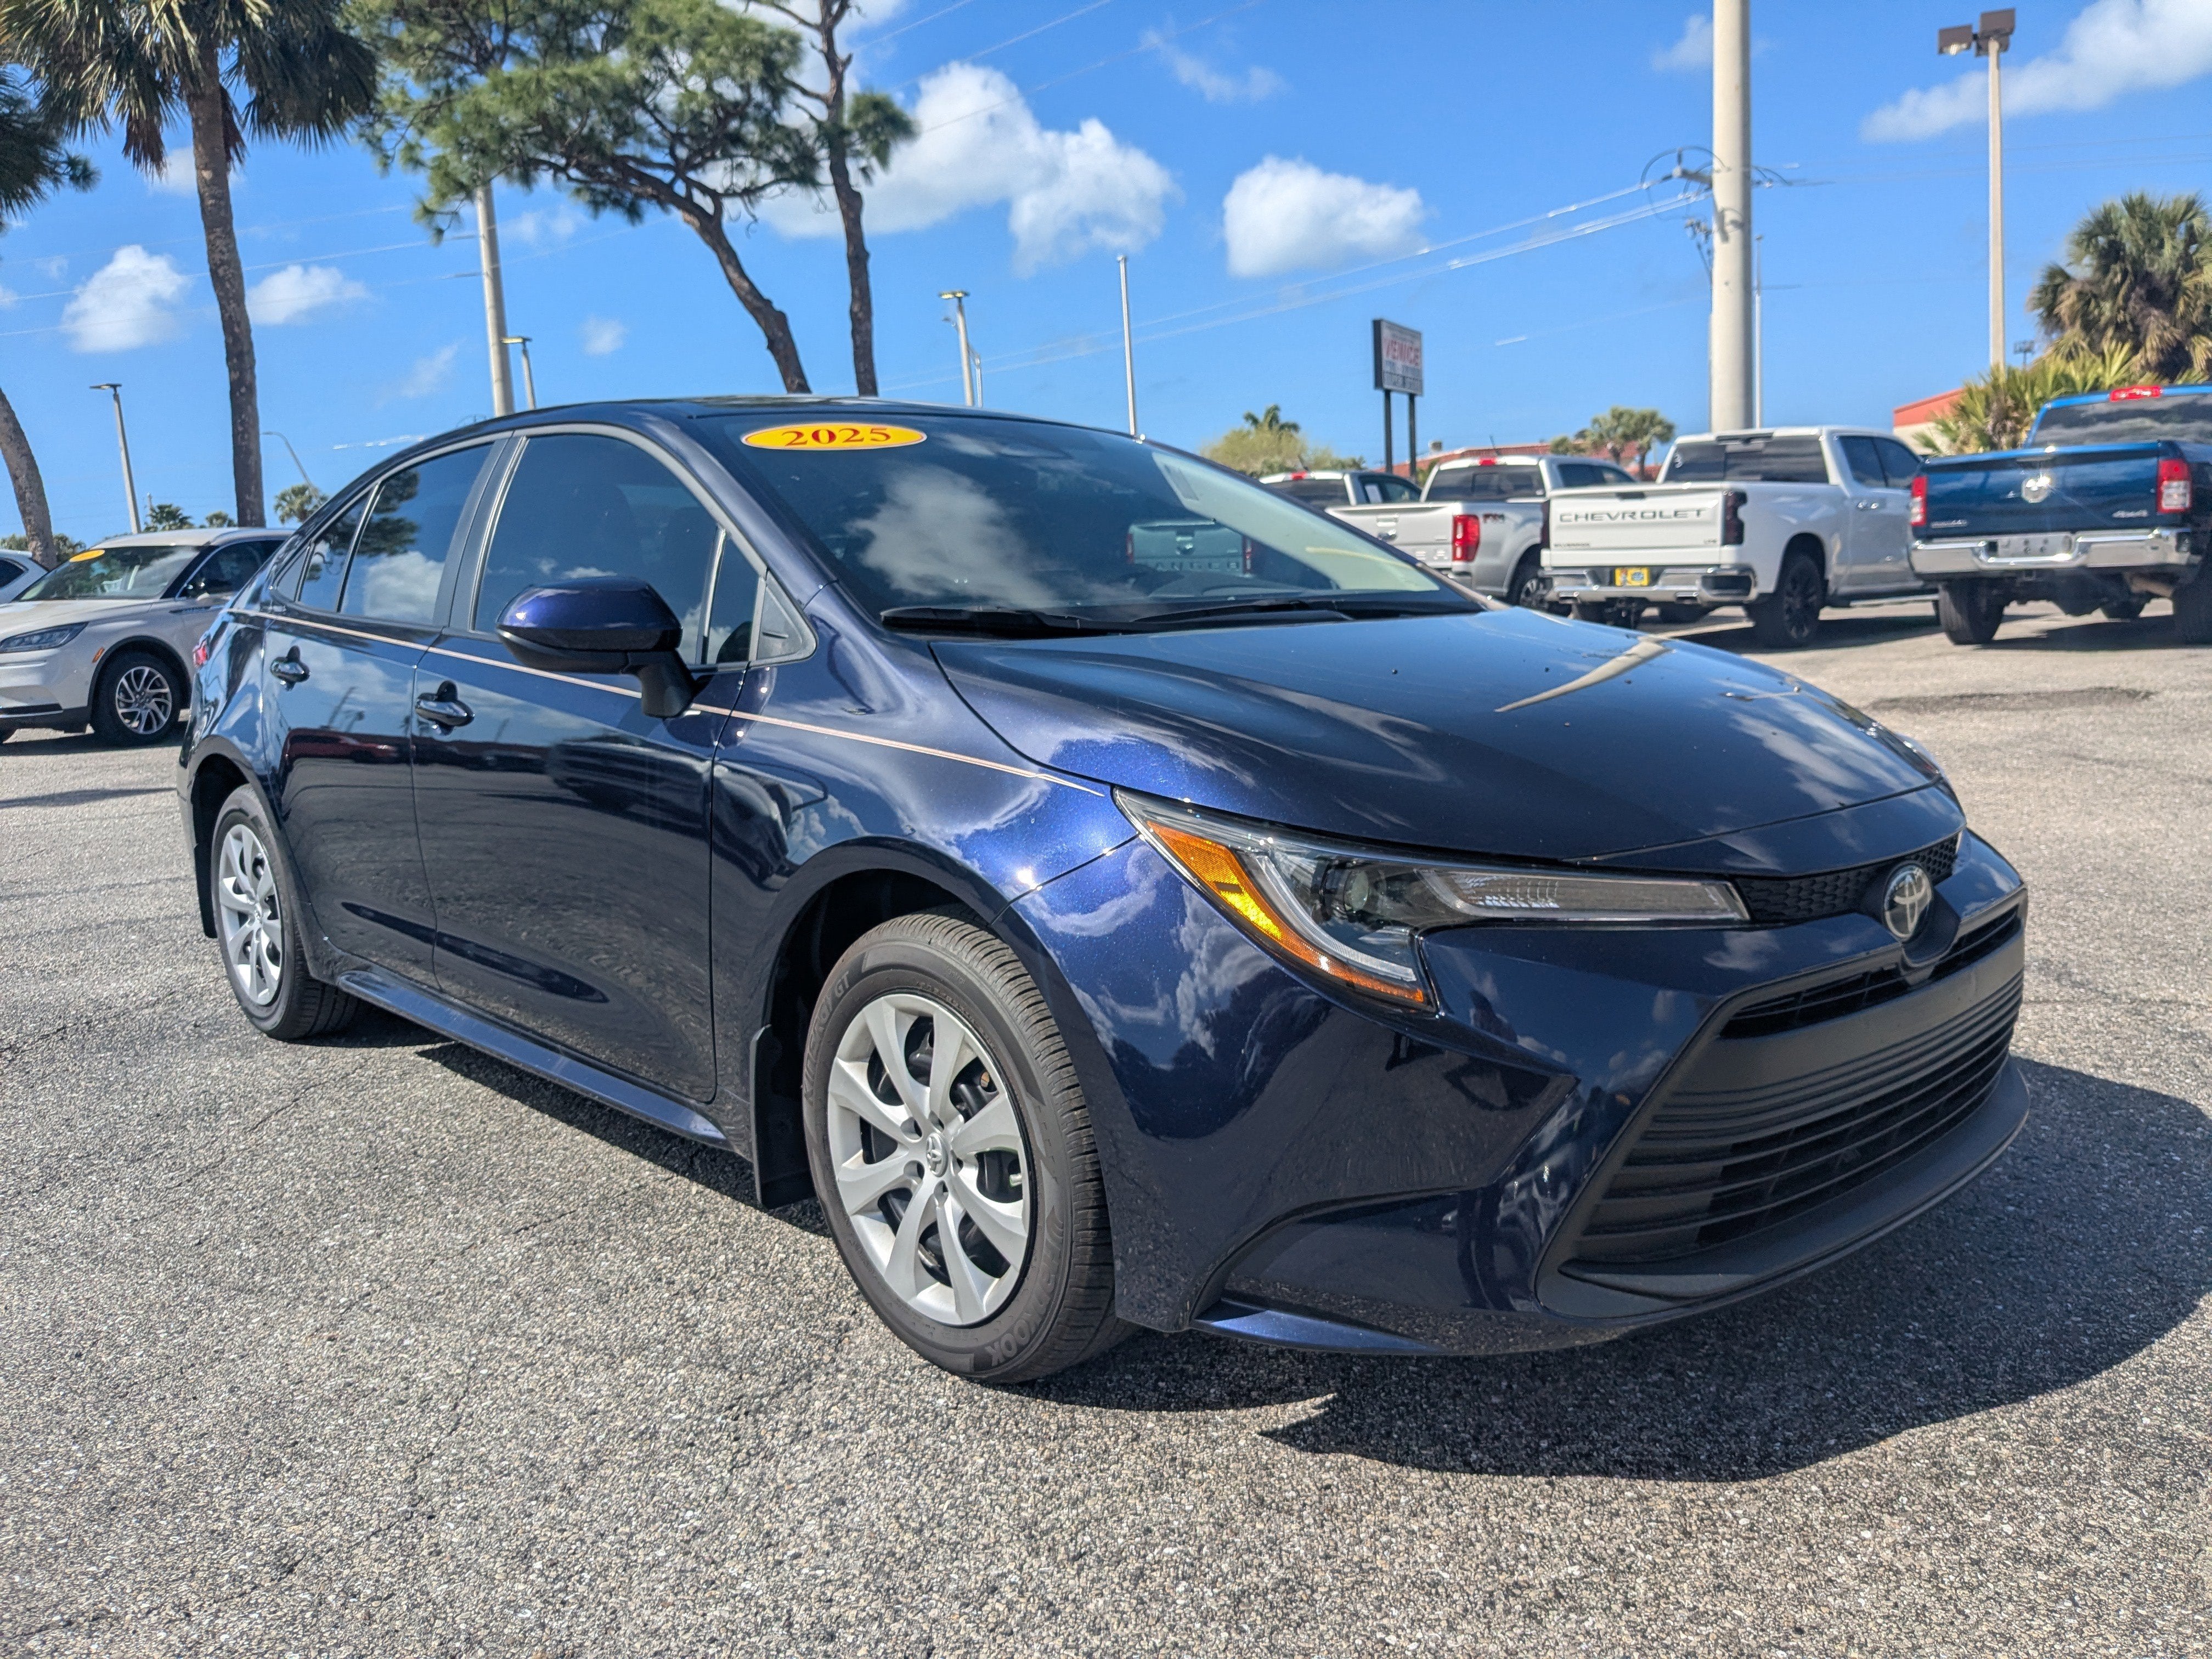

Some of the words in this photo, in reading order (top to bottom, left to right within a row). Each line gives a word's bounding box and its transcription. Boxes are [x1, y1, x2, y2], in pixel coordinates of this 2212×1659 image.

[781, 427, 891, 447] 2025
[1560, 507, 1707, 523] CHEVROLET
[834, 971, 850, 998] GT
